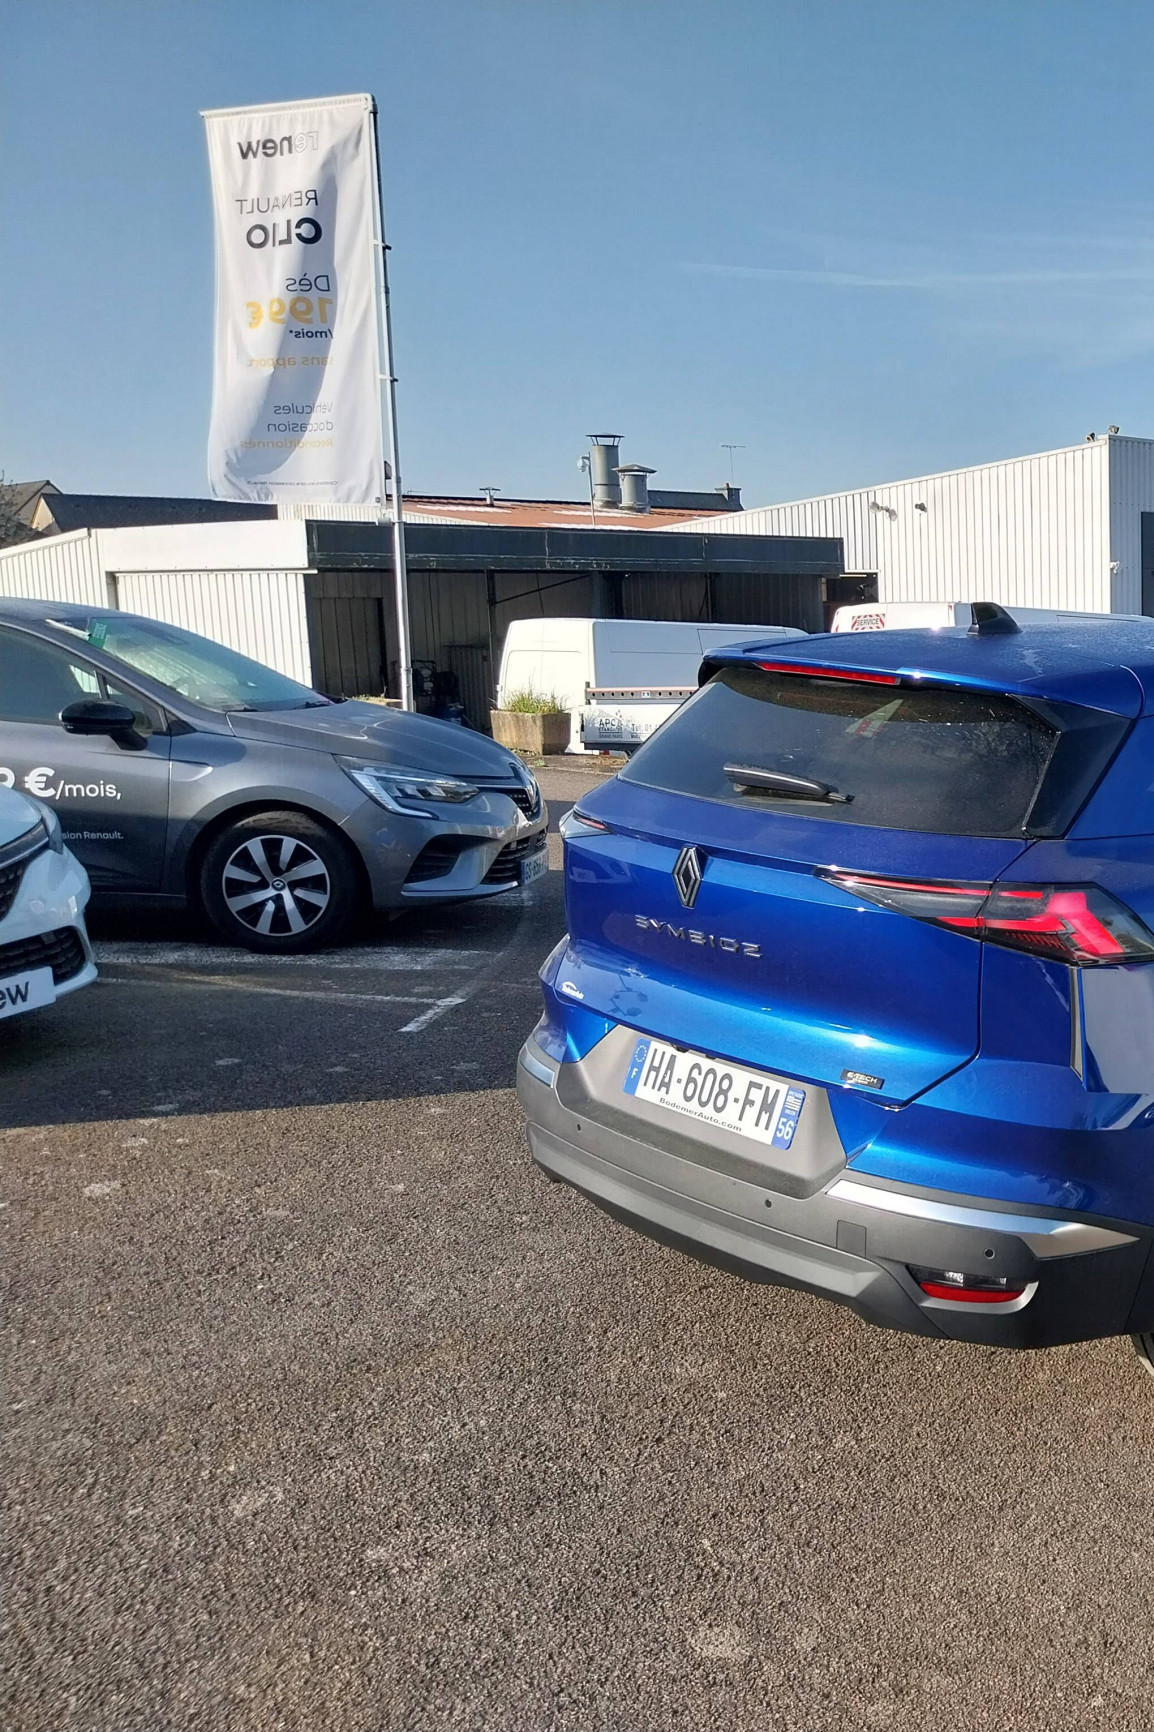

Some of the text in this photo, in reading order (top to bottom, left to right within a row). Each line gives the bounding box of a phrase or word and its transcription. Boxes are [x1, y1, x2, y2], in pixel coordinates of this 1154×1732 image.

[857, 618, 880, 626] SERVICE
[83, 830, 124, 840] Renault.
[630, 1068, 638, 1079] F
[643, 1048, 781, 1131] HA-608-FM
[659, 1097, 742, 1132] BodemerAuto.com
[776, 1116, 795, 1141] 56
